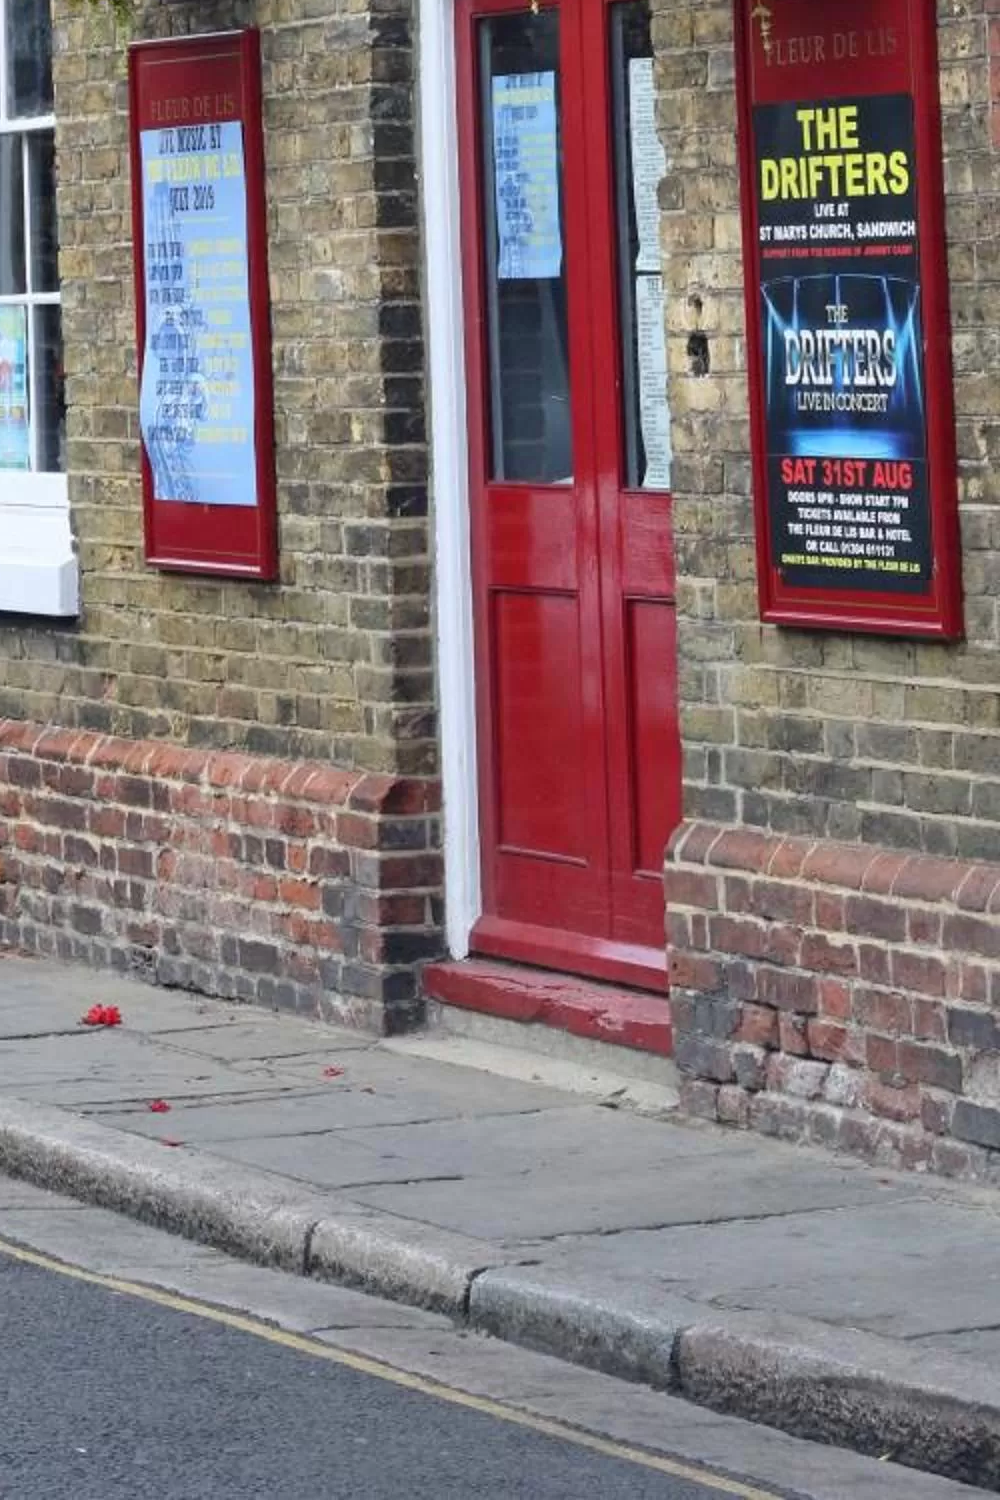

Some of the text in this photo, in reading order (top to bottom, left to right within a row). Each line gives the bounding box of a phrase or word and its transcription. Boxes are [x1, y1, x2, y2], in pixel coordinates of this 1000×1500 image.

[765, 26, 898, 68] FLEUR DE LIS
[150, 91, 235, 121] FLEUR DE LIS
[796, 105, 860, 151] THE
[760, 151, 910, 200] DRIFTERS
[814, 202, 850, 218] LIVE AT
[759, 225, 772, 241] ST
[856, 220, 916, 238] SANDWICH
[825, 305, 849, 323] THE
[783, 329, 897, 387] DRIFTERS
[797, 391, 889, 412] LIVE IN CONCERT
[782, 457, 913, 489] SAT 31ST AUG
[820, 541, 840, 553] CALL
